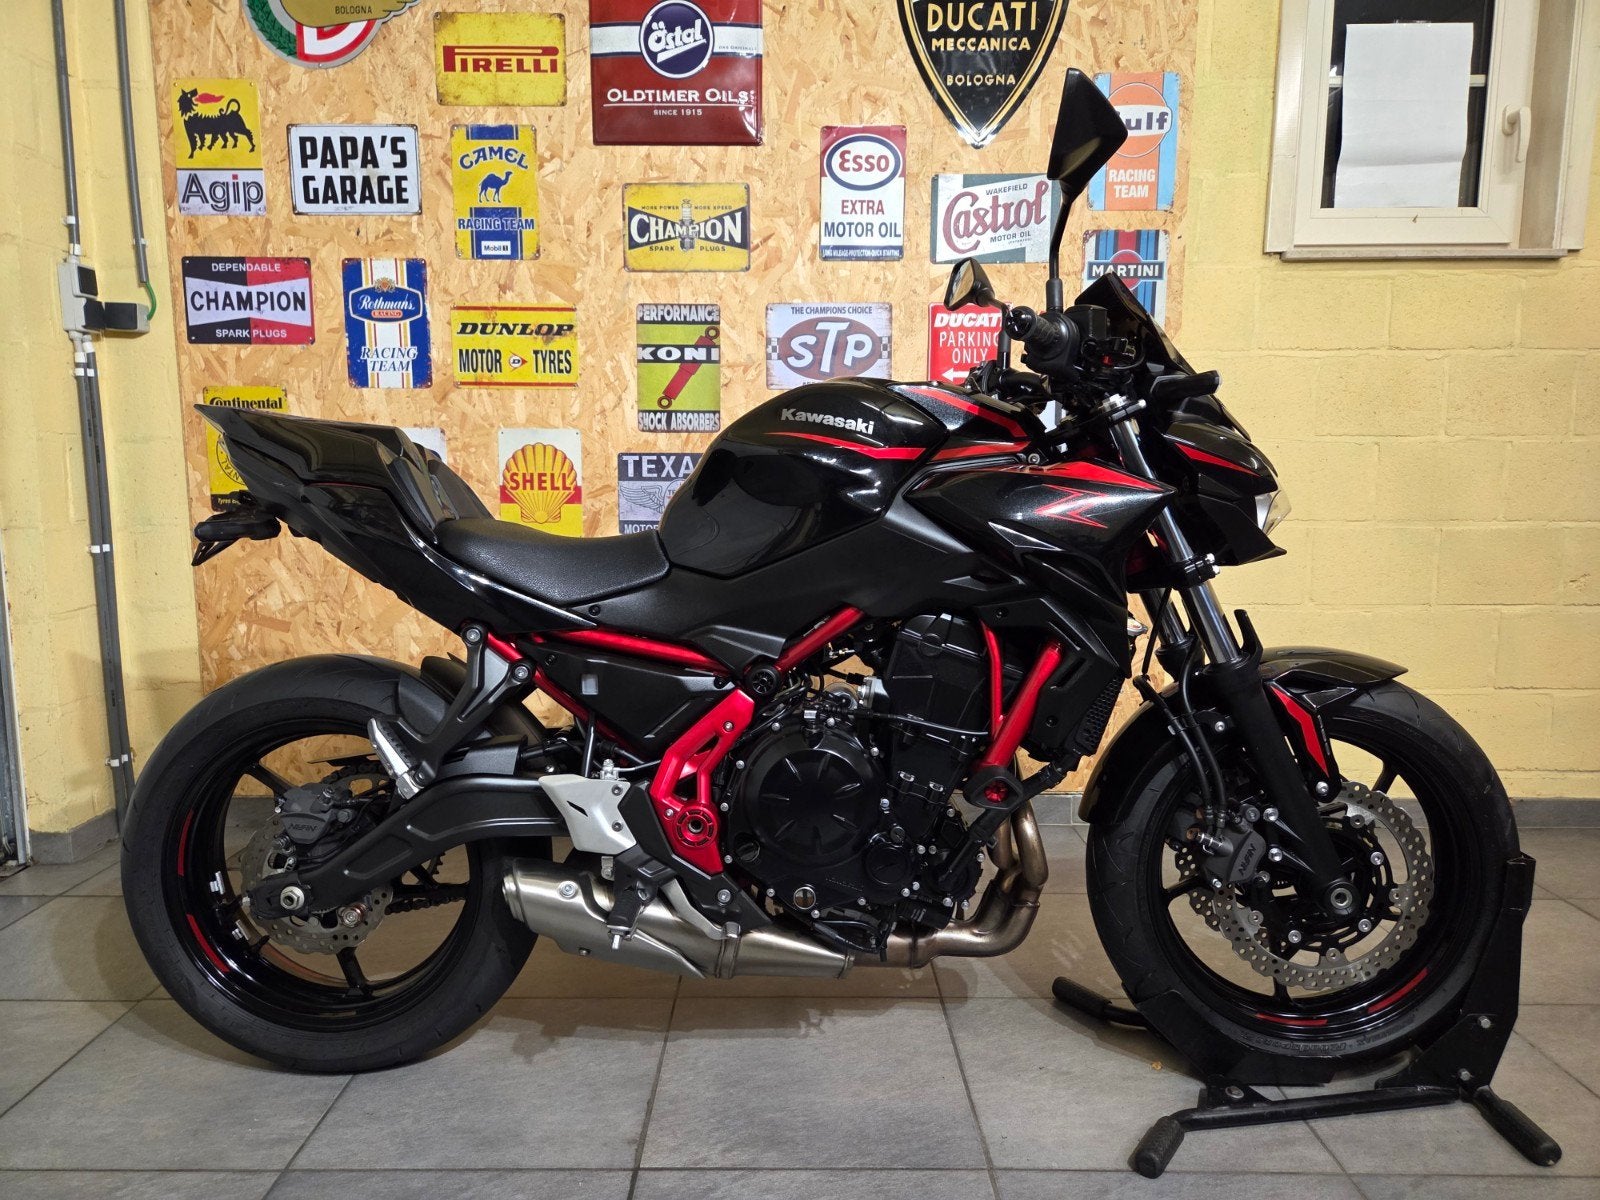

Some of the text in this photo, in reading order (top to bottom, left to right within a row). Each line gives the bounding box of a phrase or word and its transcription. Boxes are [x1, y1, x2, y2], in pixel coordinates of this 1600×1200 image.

[335, 5, 372, 15] BOLOGNA
[927, 1, 1037, 31] DUCATI
[931, 37, 1031, 52] MECCANICA
[443, 45, 559, 73] PIRELLI
[946, 74, 1016, 87] BOLOGNA
[607, 88, 748, 103] OLDTIMER OILS
[681, 108, 702, 116] 1915
[1117, 111, 1168, 131] ulf
[299, 135, 407, 169] PAPA'S
[459, 146, 529, 169] CAMEL
[1108, 169, 1155, 182] RACING
[181, 173, 264, 212] Agip
[302, 175, 409, 204] GARAGE
[985, 183, 1028, 196] WAKEFIELD
[1114, 185, 1149, 198] TEAM
[840, 200, 885, 215] EXTRA
[457, 218, 535, 230] RACING TEAM
[942, 180, 1049, 254] Castrol
[630, 211, 743, 244] CHAMPION
[824, 222, 901, 238] MOTOR OIL
[989, 232, 1017, 243] MOTOR
[1019, 230, 1031, 238] OIL
[211, 262, 281, 273] DEPENDABLE
[1092, 264, 1159, 277] MARTINI
[190, 290, 307, 313] CHAMPION
[374, 310, 401, 318] RACING
[637, 305, 720, 322] PERFORMANCE
[791, 306, 873, 315] THE CHAMPIONS CHOICE
[215, 328, 287, 339] SPARK PLUGS
[456, 322, 574, 337] DUNLOP
[361, 346, 418, 360] RACING
[637, 346, 720, 361] KONI
[786, 321, 873, 373] STP
[458, 349, 503, 375] MOTOR
[533, 349, 572, 375] TYRES
[952, 348, 988, 364] ONLY
[369, 359, 411, 373] TEAM
[638, 412, 720, 431] SHOCK ABSORBERS
[780, 408, 875, 435] Kawasaki
[622, 455, 695, 478] TEXA
[509, 473, 574, 491] SHELL
